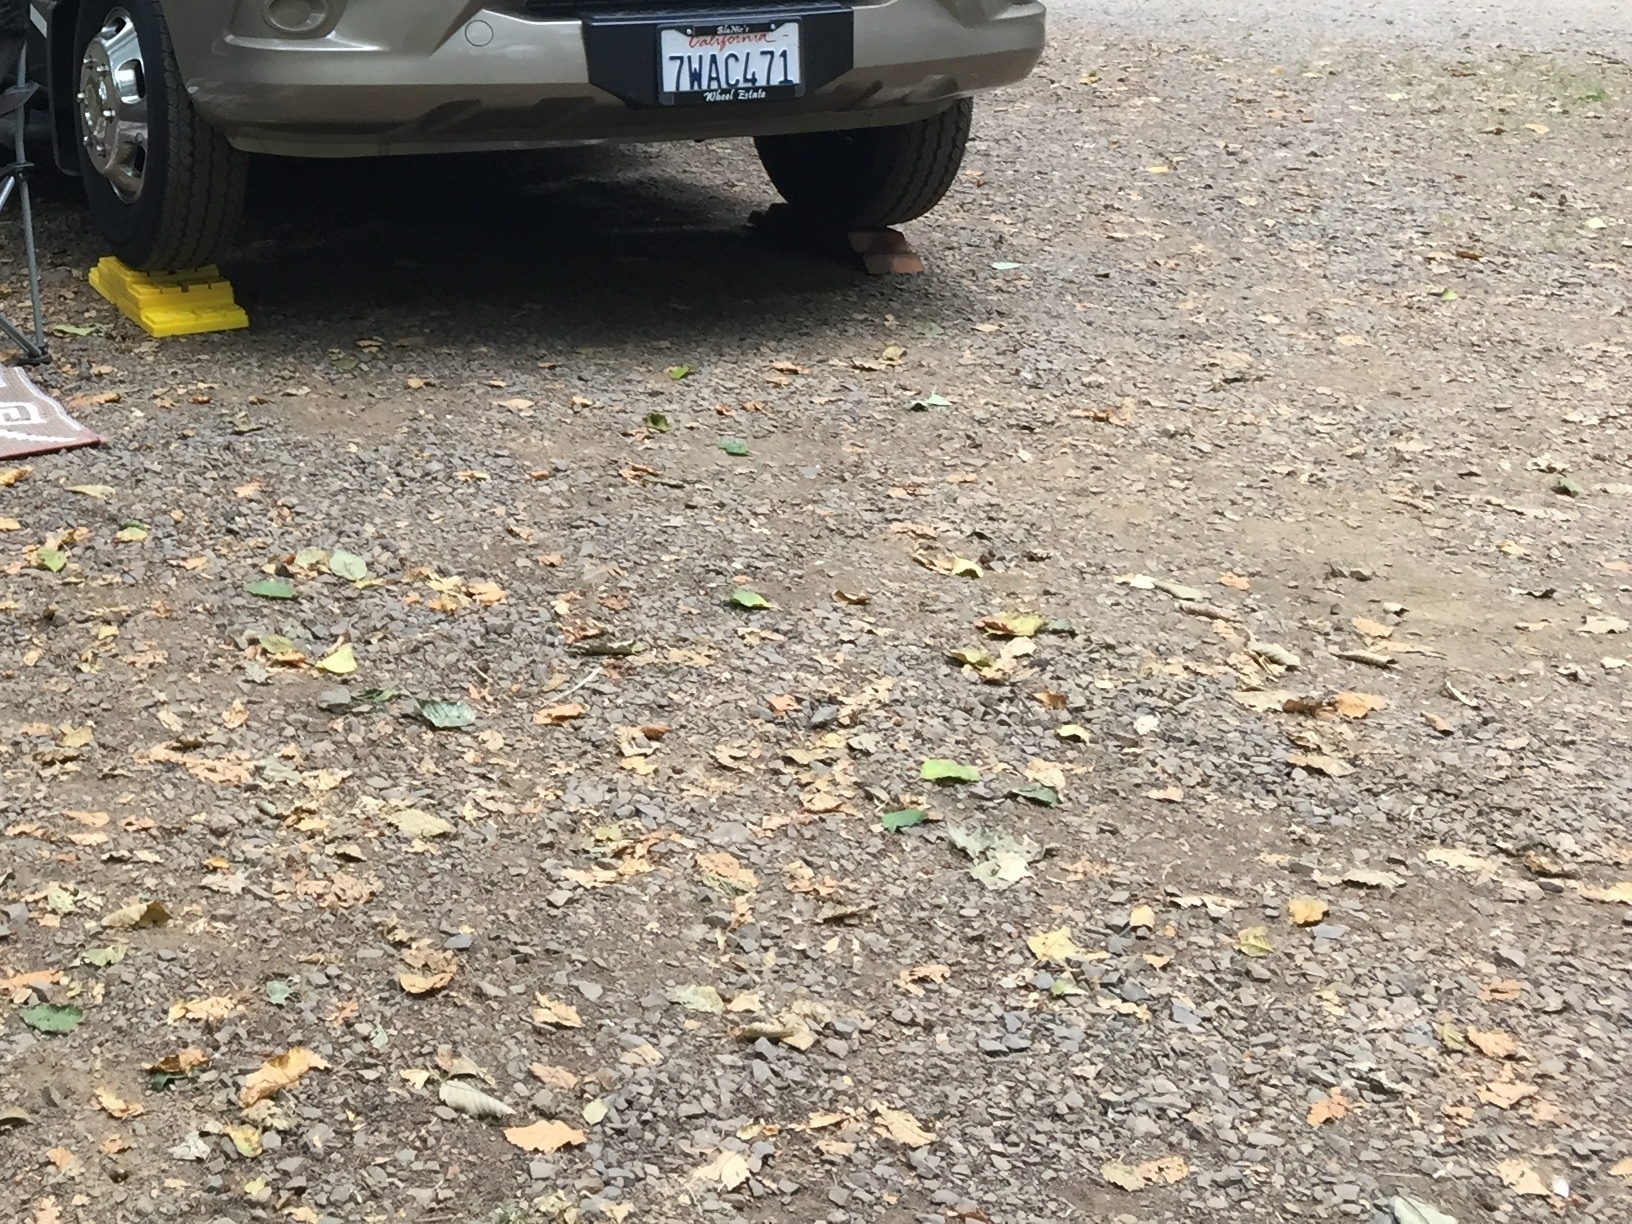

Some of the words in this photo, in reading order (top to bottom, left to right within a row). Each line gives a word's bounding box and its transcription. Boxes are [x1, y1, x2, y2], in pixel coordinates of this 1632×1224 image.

[688, 33, 776, 52] California
[668, 49, 794, 92] 7WAC471
[703, 89, 734, 102] Wheel
[737, 88, 767, 100] Estate
